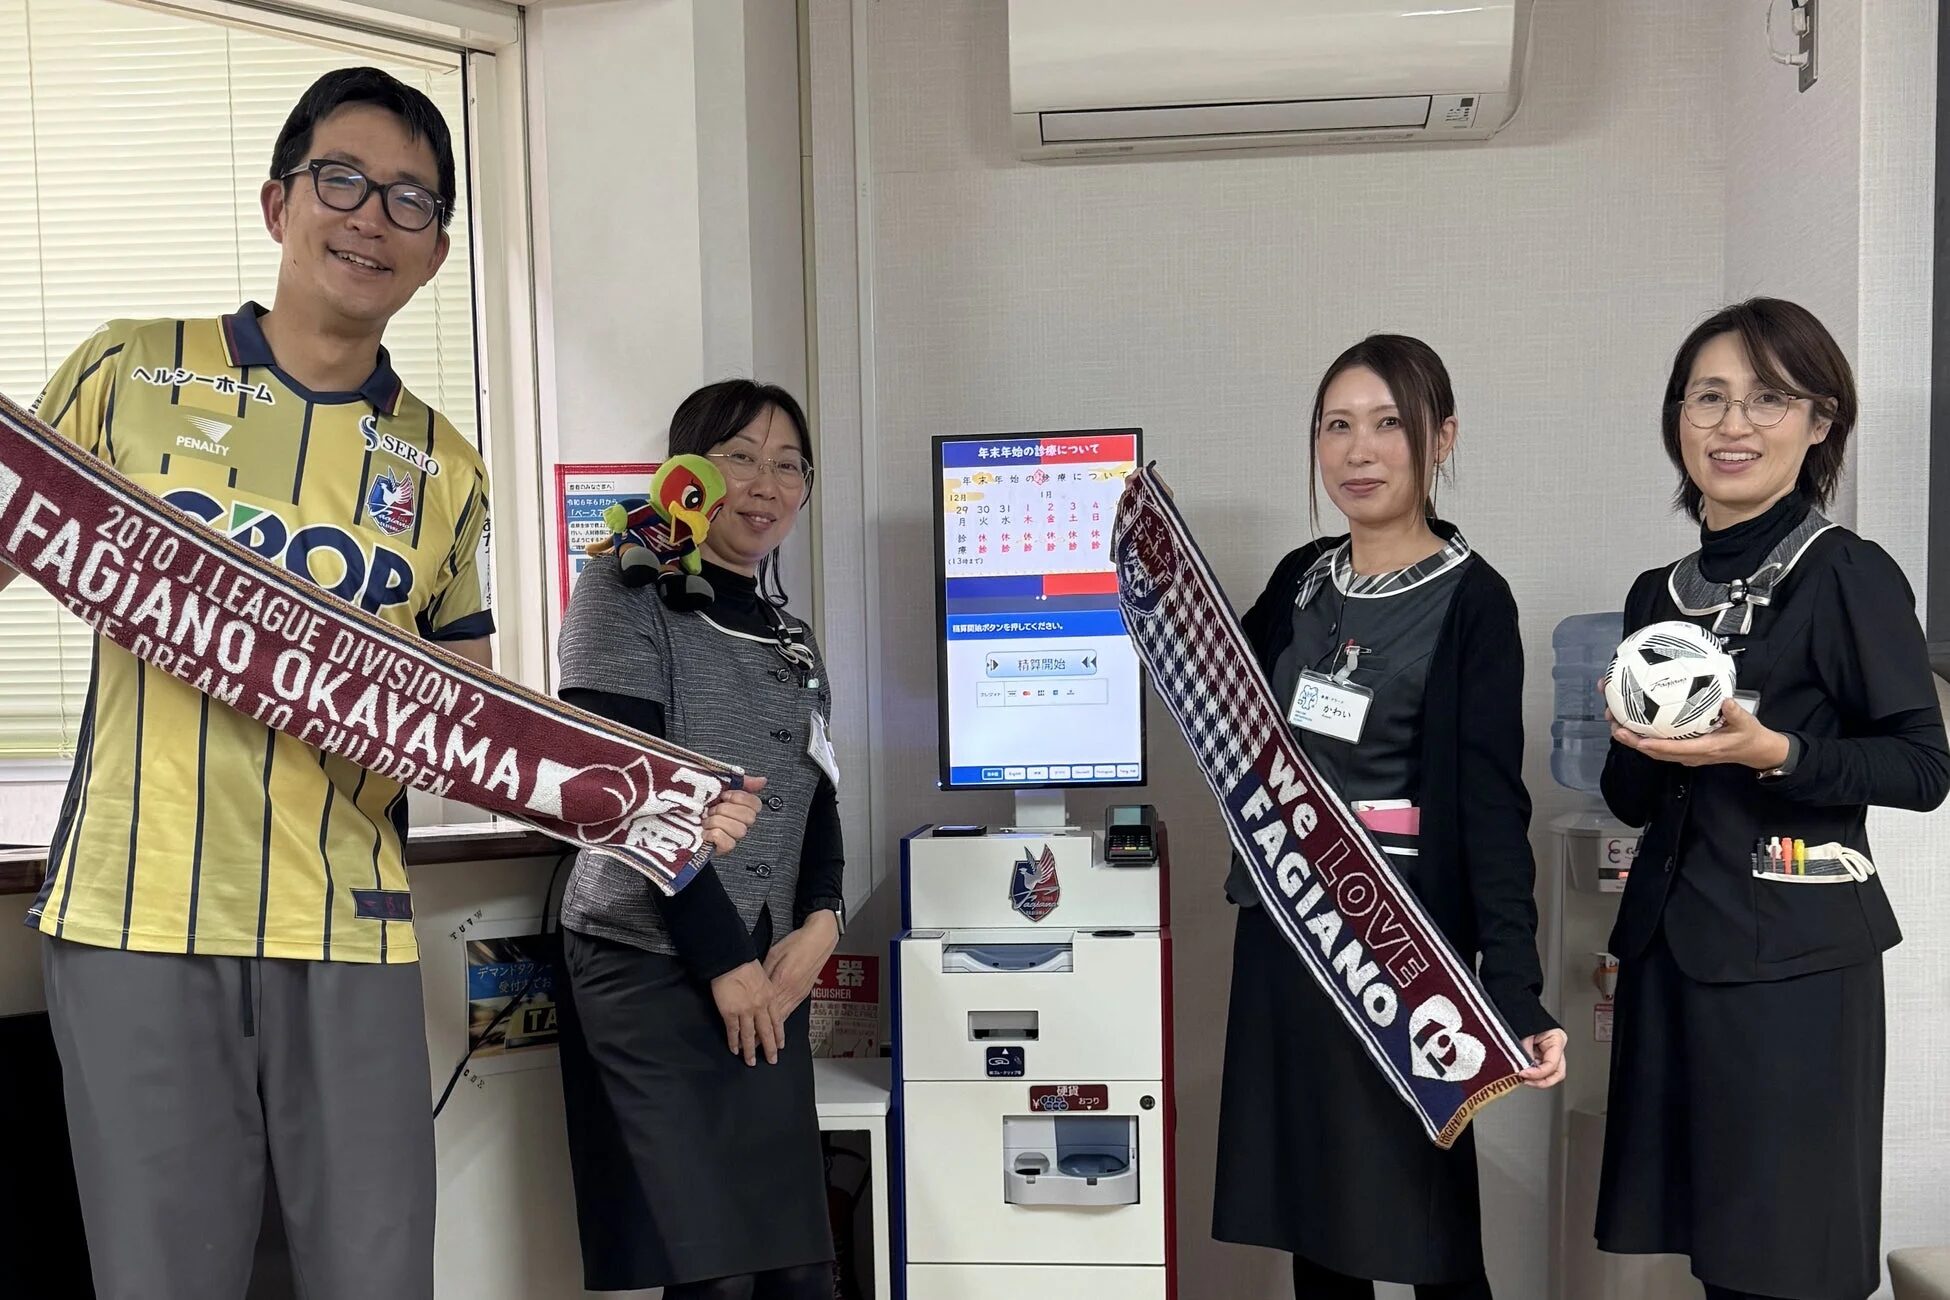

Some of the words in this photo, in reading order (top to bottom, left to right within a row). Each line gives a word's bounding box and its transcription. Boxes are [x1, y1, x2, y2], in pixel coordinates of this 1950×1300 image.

[132, 367, 275, 404] ヘルシーホーム
[176, 435, 229, 457] PENALTY
[382, 434, 440, 477] SERIO
[978, 443, 1100, 459] 年末年始の診療について
[950, 493, 968, 502] 12月
[1040, 490, 1052, 499] 1月
[956, 506, 969, 514] 29
[977, 505, 990, 514] 30
[999, 504, 1011, 513] 31
[1048, 503, 1054, 511] 2
[1070, 502, 1076, 511] 3
[958, 517, 967, 526] 月
[979, 517, 989, 526] 火
[1001, 516, 1011, 525] 水
[1046, 514, 1056, 523] 金
[1069, 513, 1078, 522] 土
[1092, 512, 1100, 521] 日
[96, 504, 180, 572] 2010
[178, 554, 326, 652] J.LEAGUE
[328, 627, 462, 718] DIVISION
[459, 692, 486, 729] 2
[1017, 657, 1066, 671] 精算開始
[130, 635, 245, 707] DREAM
[252, 691, 295, 732] TO
[297, 717, 456, 798] CHILDREN
[1323, 704, 1351, 718] かわい
[271, 649, 521, 801] OKAYAMA
[1239, 783, 1399, 1029] FAGIANO
[1314, 837, 1430, 989] LOVE
[1056, 1085, 1079, 1097] 硬貨
[1079, 1097, 1100, 1105] おつり
